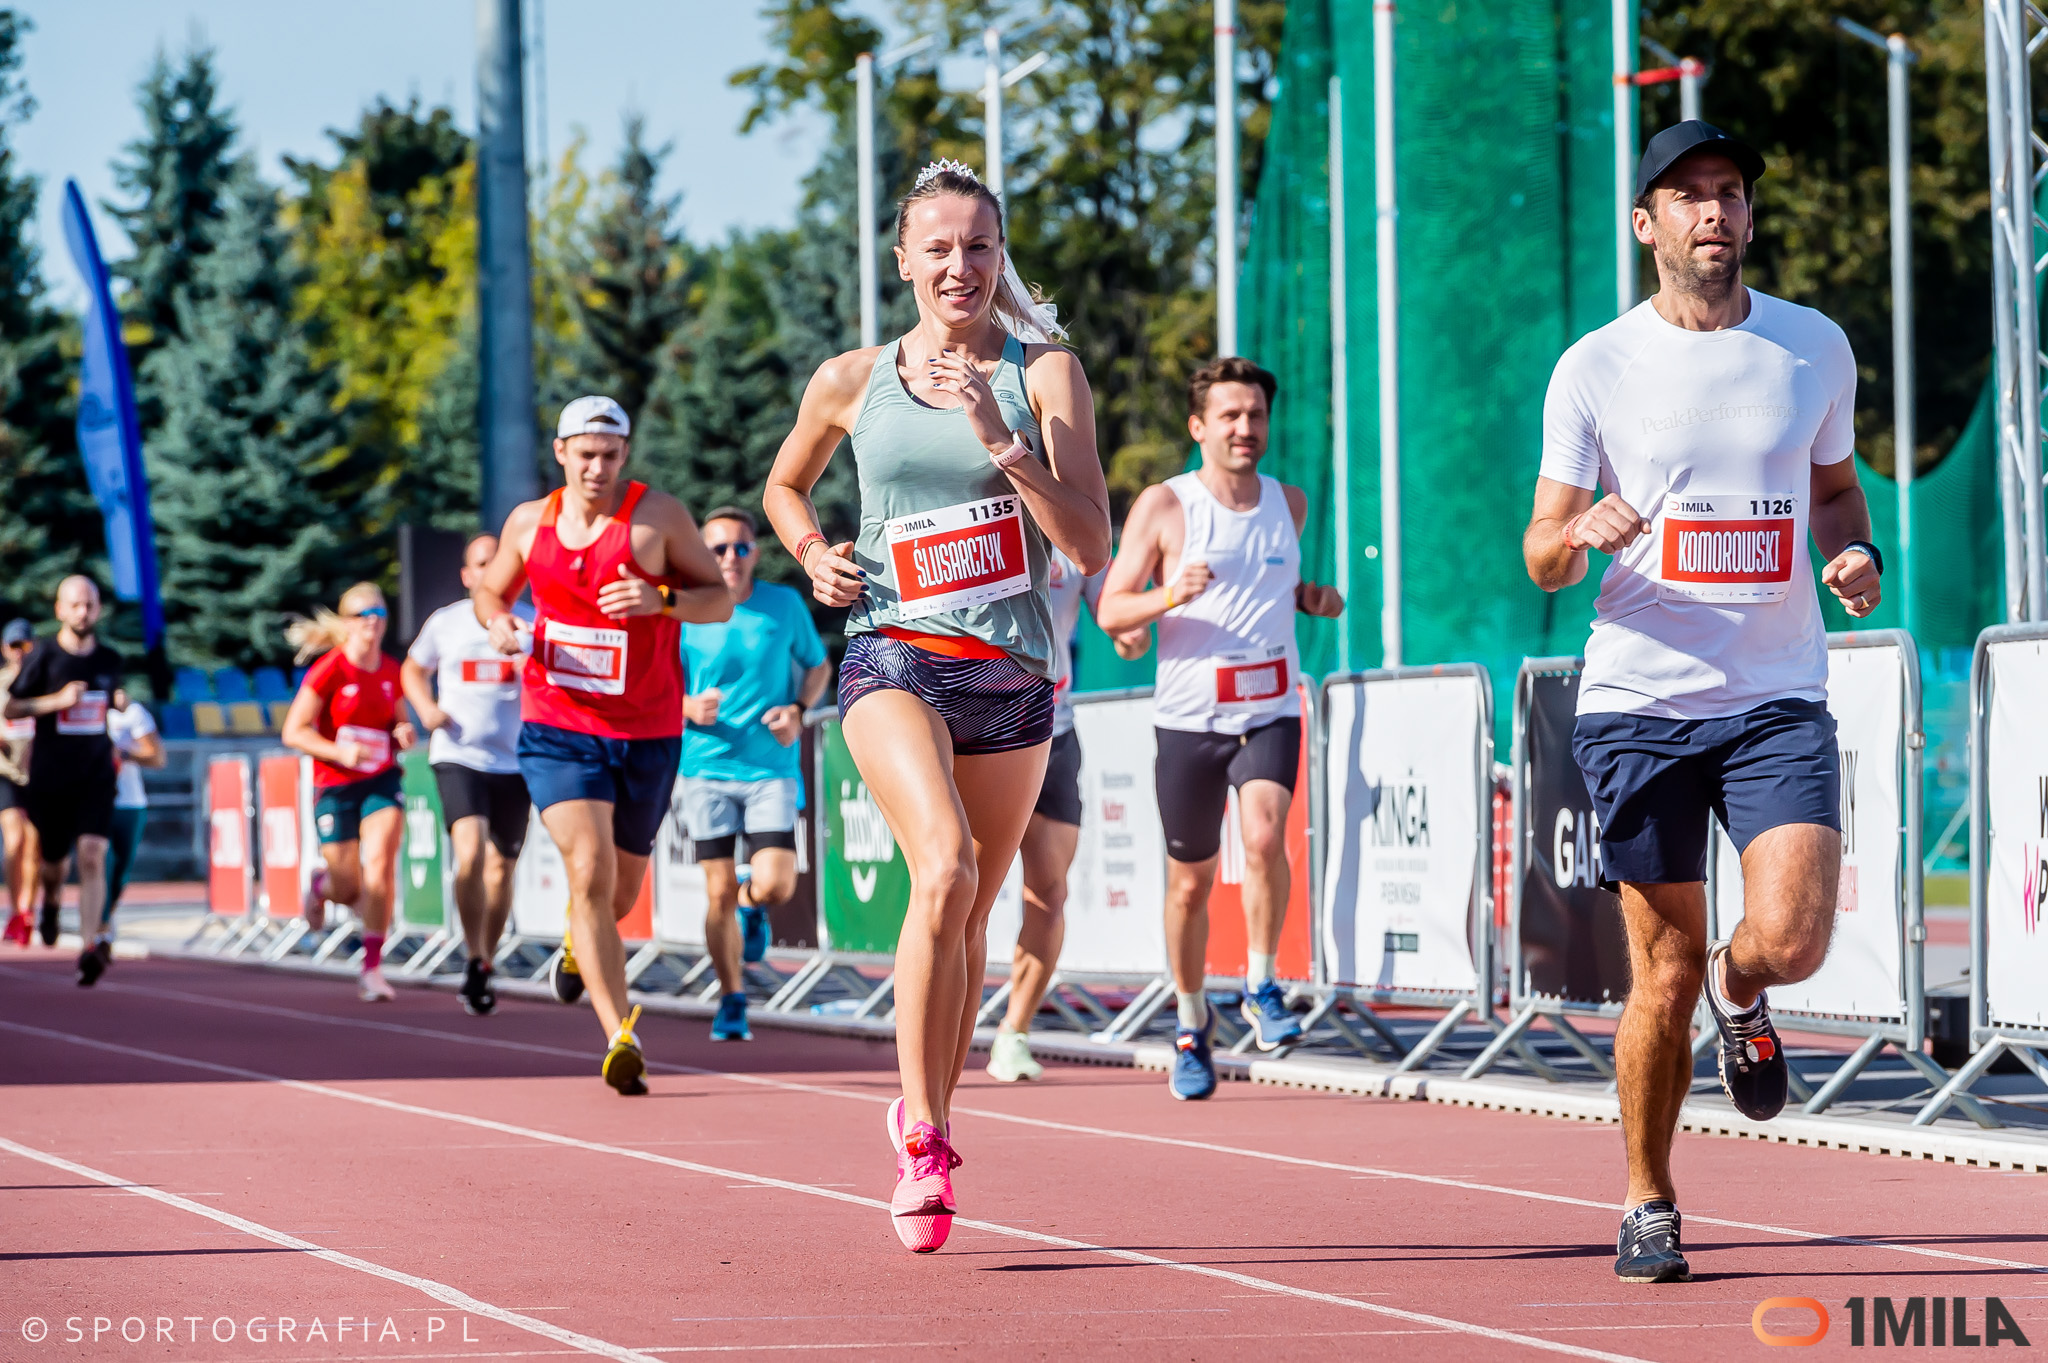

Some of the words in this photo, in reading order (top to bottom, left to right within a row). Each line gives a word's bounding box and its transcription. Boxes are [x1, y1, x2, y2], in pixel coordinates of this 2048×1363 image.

[969, 500, 1015, 522] 1135
[1681, 502, 1715, 513] 1MILA
[1750, 500, 1793, 516] 1126
[904, 518, 936, 532] 1MILA
[912, 532, 1006, 589] ŚLUSARCZYK
[1678, 530, 1781, 573] KOMOROWSKI
